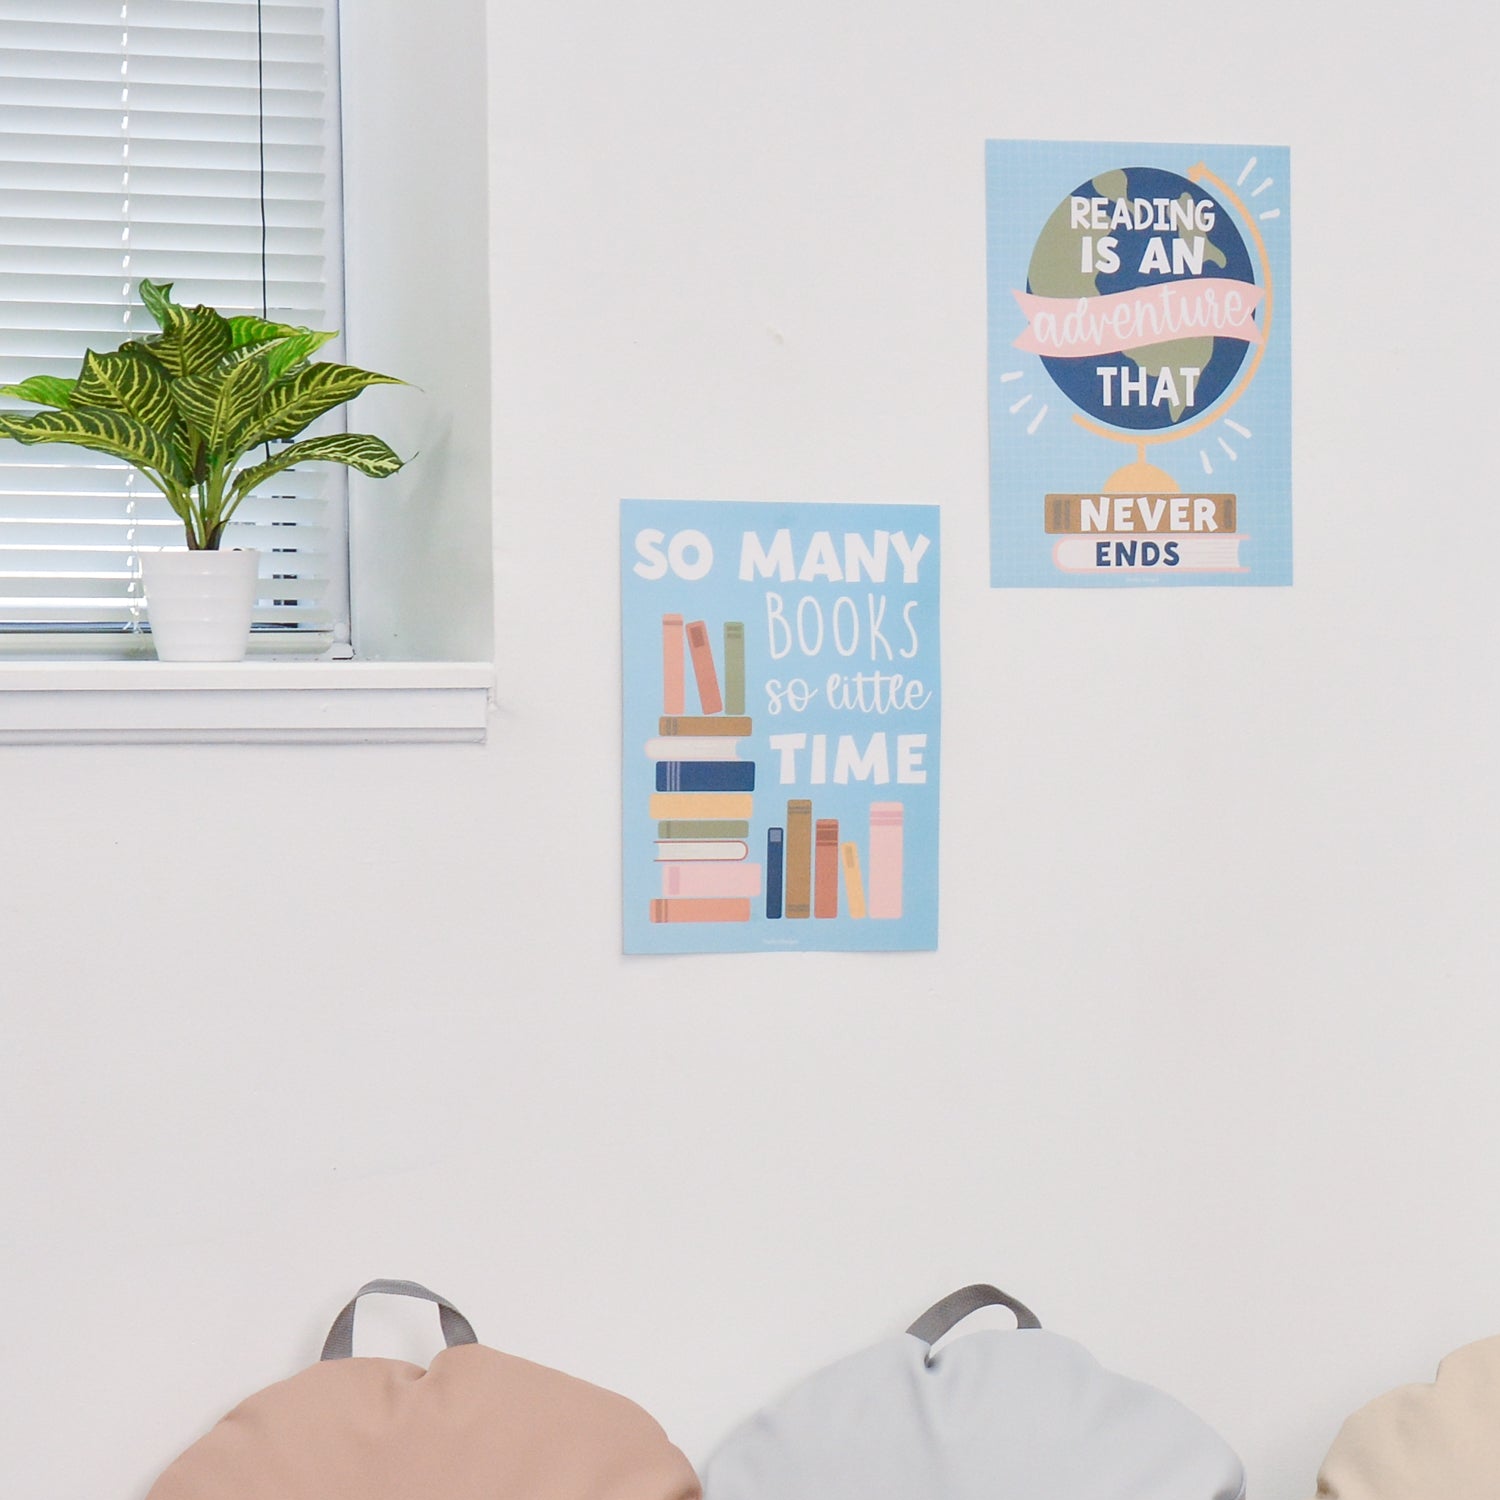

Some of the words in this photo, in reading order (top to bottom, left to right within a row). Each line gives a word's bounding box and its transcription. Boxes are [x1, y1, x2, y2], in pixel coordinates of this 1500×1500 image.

[1070, 197, 1215, 233] READING
[1081, 235, 1121, 274] IS
[1138, 236, 1205, 275] AN
[1033, 285, 1249, 348] adventure
[1096, 366, 1200, 407] THAT
[1080, 496, 1218, 532] NEVER
[633, 528, 713, 581] SO
[738, 528, 931, 583] MANY
[1095, 540, 1180, 567] ENDS
[765, 591, 919, 660] BOOKS
[765, 677, 818, 715] so
[826, 670, 932, 711] little
[769, 732, 927, 785] TIME
